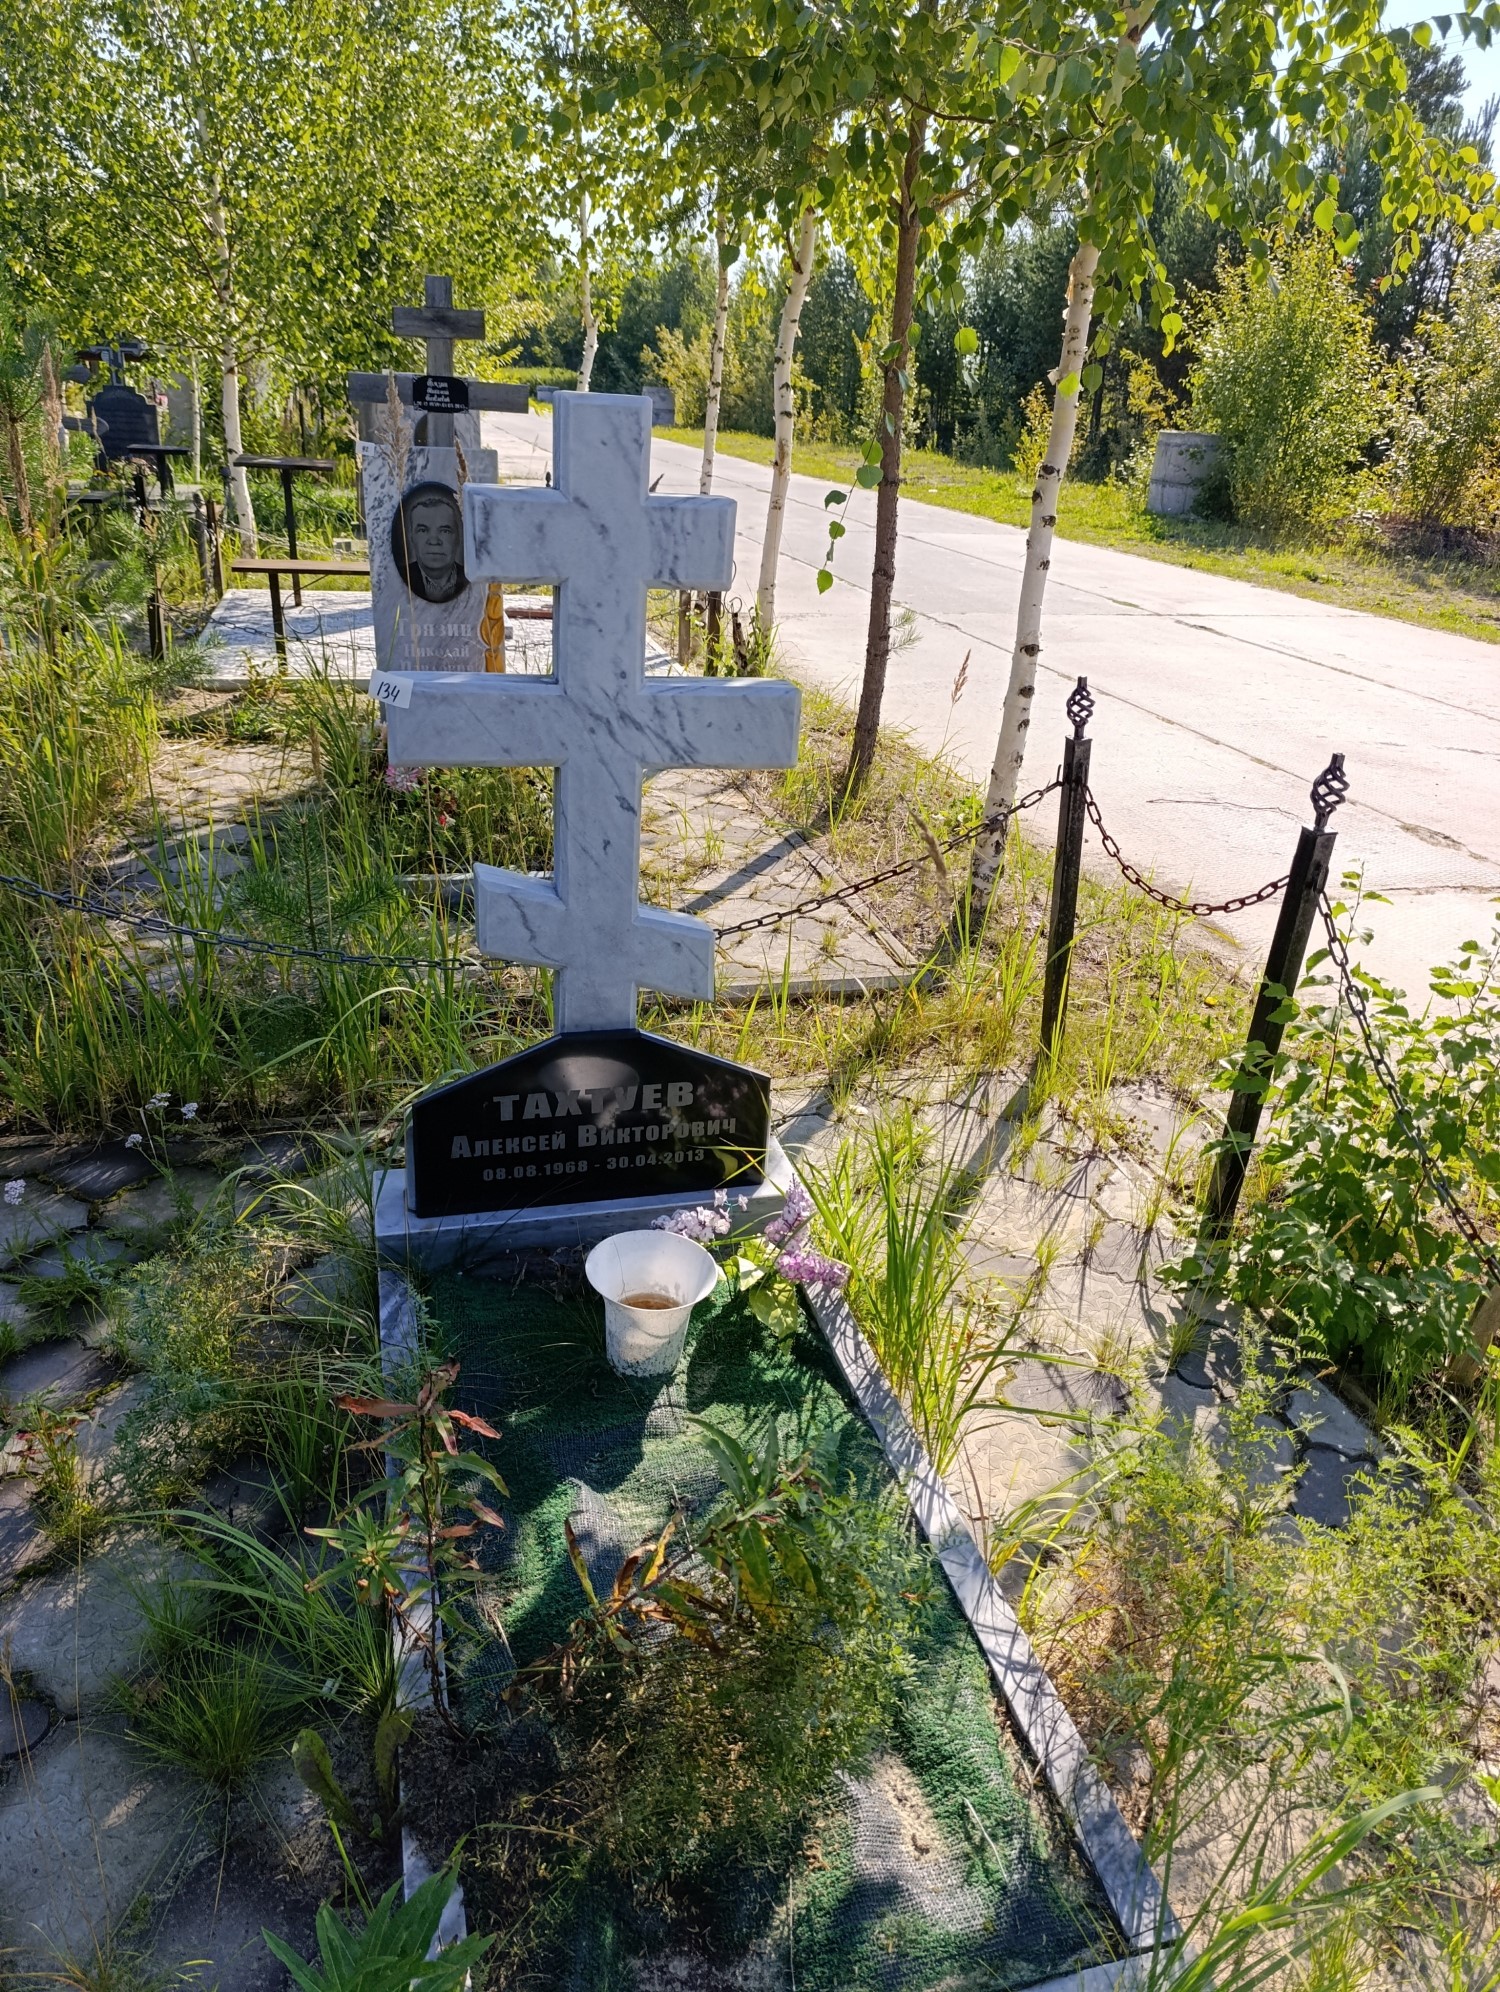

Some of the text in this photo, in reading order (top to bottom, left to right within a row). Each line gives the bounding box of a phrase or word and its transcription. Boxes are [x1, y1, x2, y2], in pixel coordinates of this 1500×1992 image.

[377, 681, 401, 703] 134
[493, 1081, 694, 1121] ТАХТУЕВ
[482, 1160, 588, 1181] 08.08.1968
[606, 1149, 705, 1170] 30.04.2013
